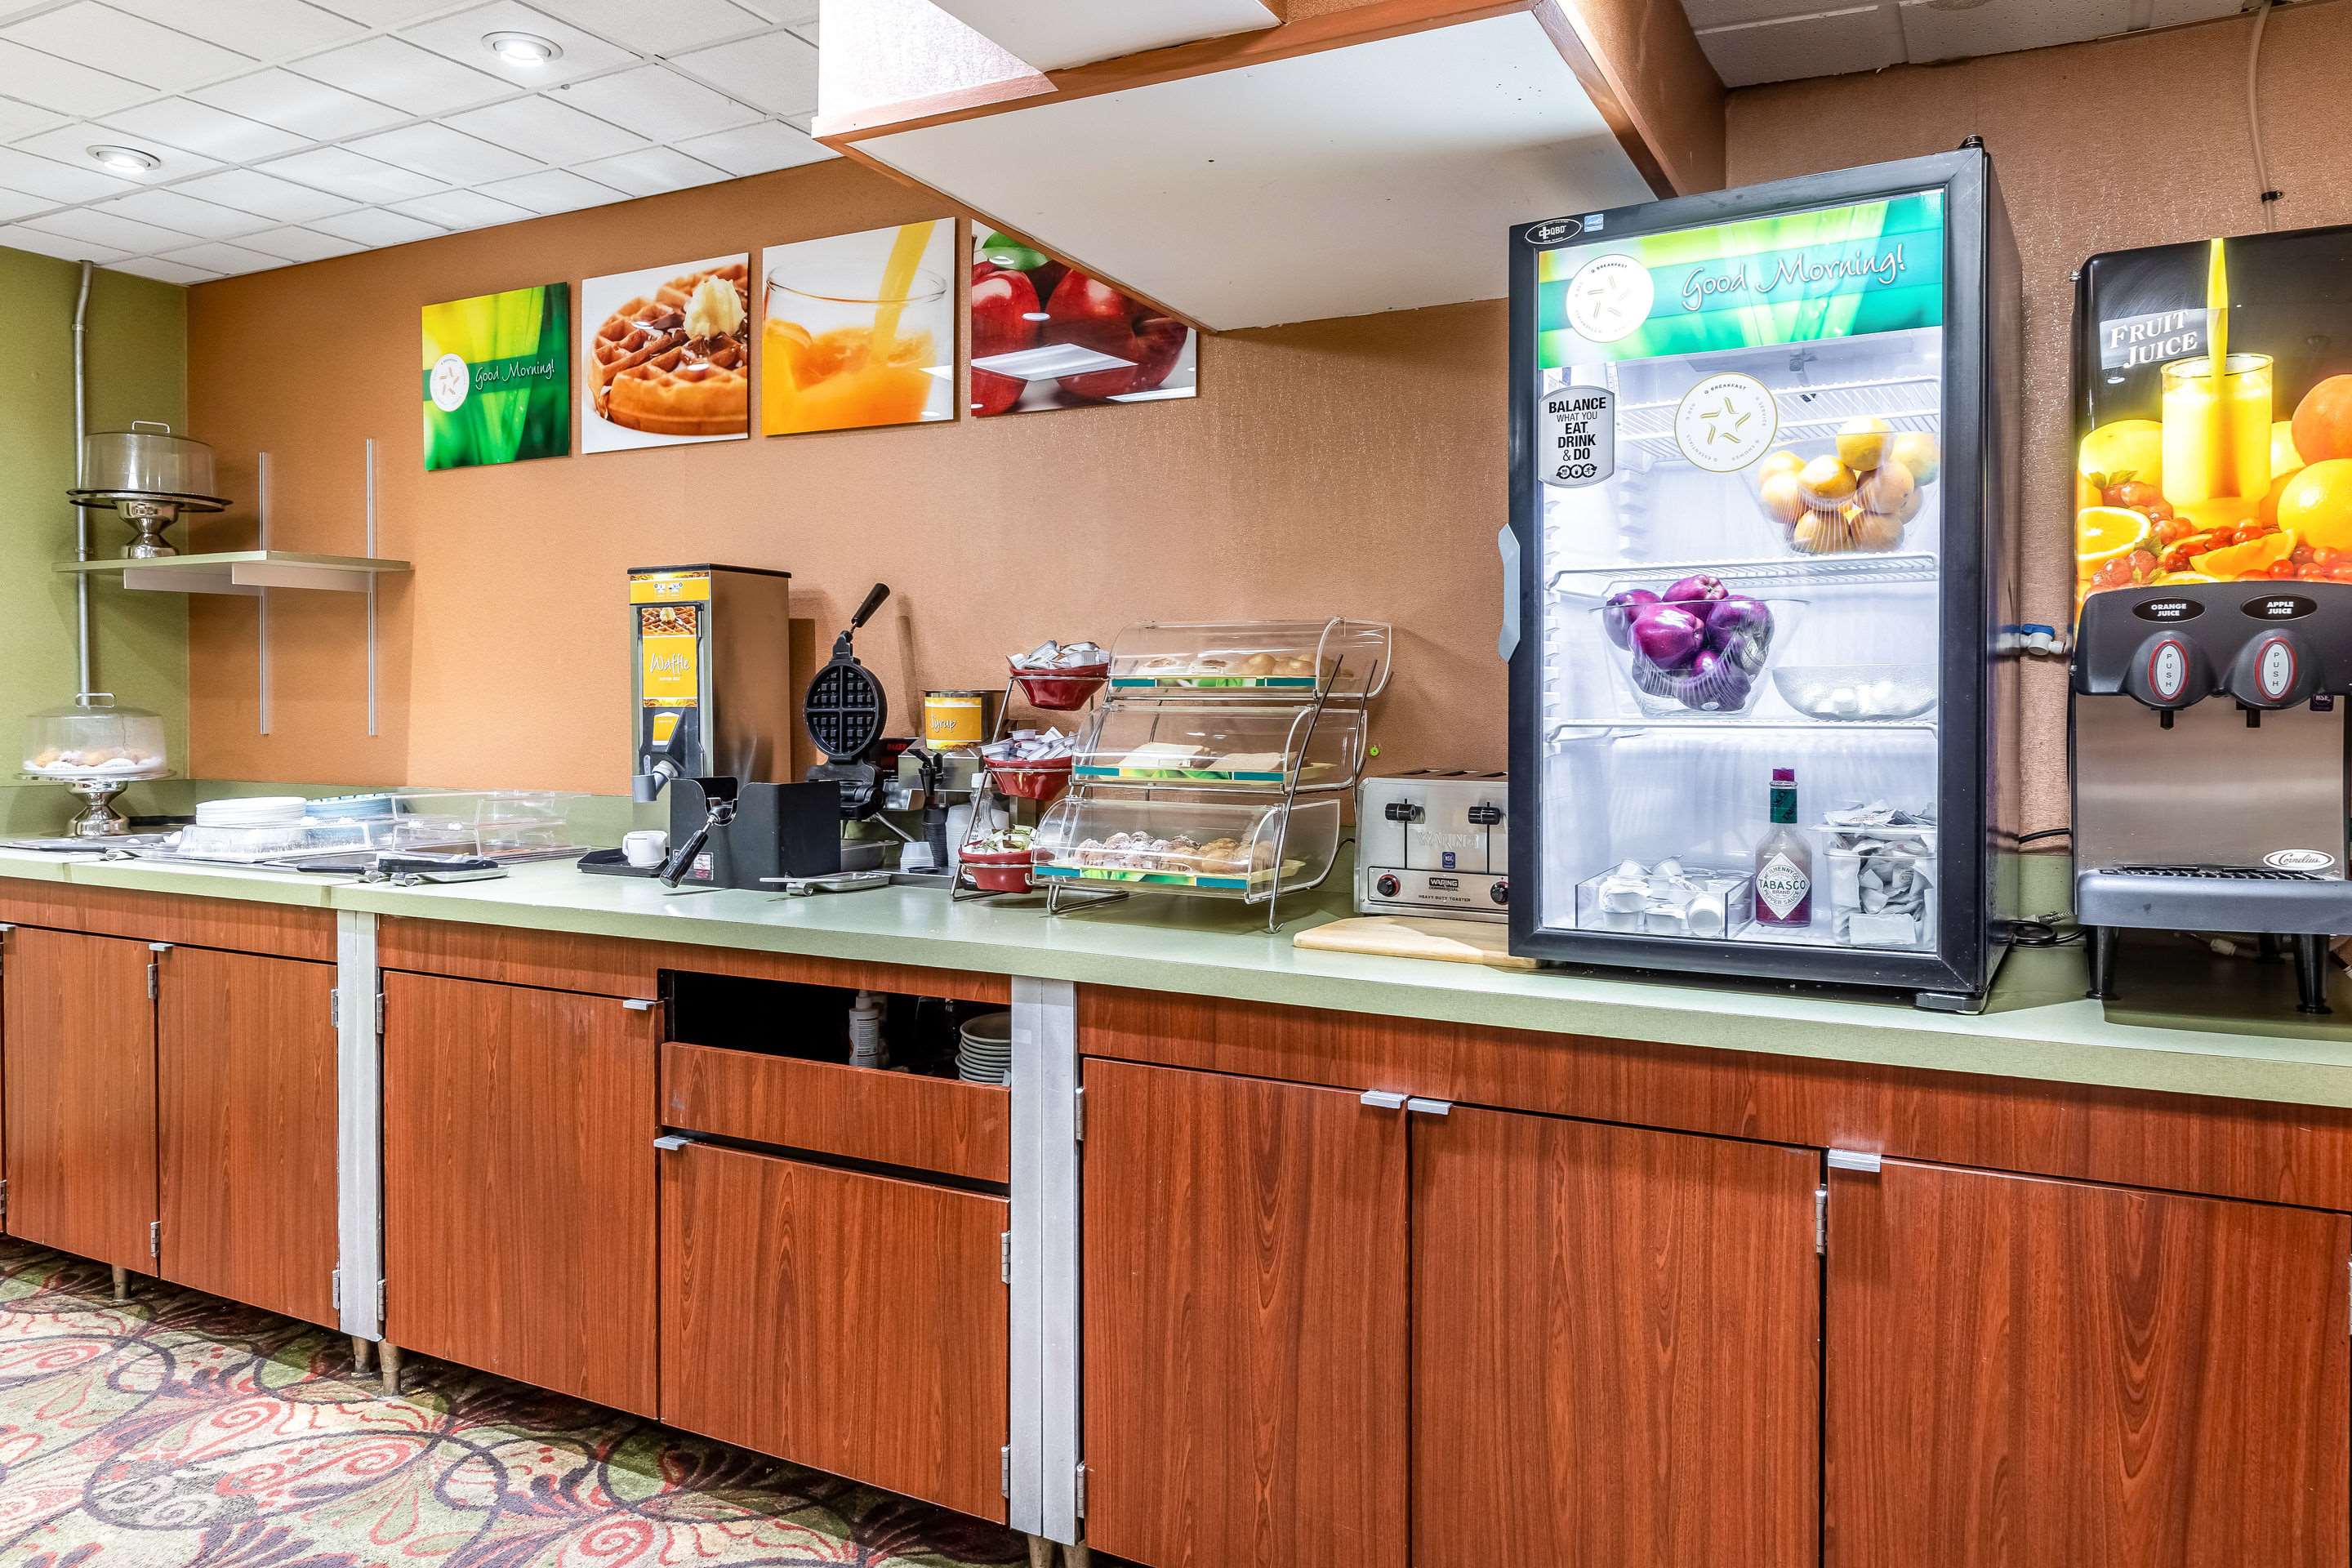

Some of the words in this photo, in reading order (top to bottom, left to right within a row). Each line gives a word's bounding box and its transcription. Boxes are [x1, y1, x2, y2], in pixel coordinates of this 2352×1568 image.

[1682, 261, 1748, 311] Good
[1756, 243, 1905, 293] Morning!
[2109, 311, 2189, 350] FRUIT
[2123, 332, 2198, 369] JUICE
[475, 366, 500, 390] Good
[502, 359, 555, 381] Morning!
[1710, 383, 1747, 391] BREAKFAST
[1548, 397, 1607, 414] BALANCE
[1557, 412, 1579, 423] WHAT
[1581, 411, 1597, 421] YOU
[1557, 434, 1597, 448] DRINK
[1562, 449, 1571, 461] &
[1574, 448, 1591, 461] DO
[649, 653, 690, 674] Waffle
[930, 714, 957, 733] Syrup
[2278, 852, 2319, 866] Cornelius
[1430, 879, 1458, 888] WARING
[1758, 879, 1806, 891] TABASCO
[1764, 889, 1782, 905] PEPPER
[1784, 891, 1800, 905] SAUCE
